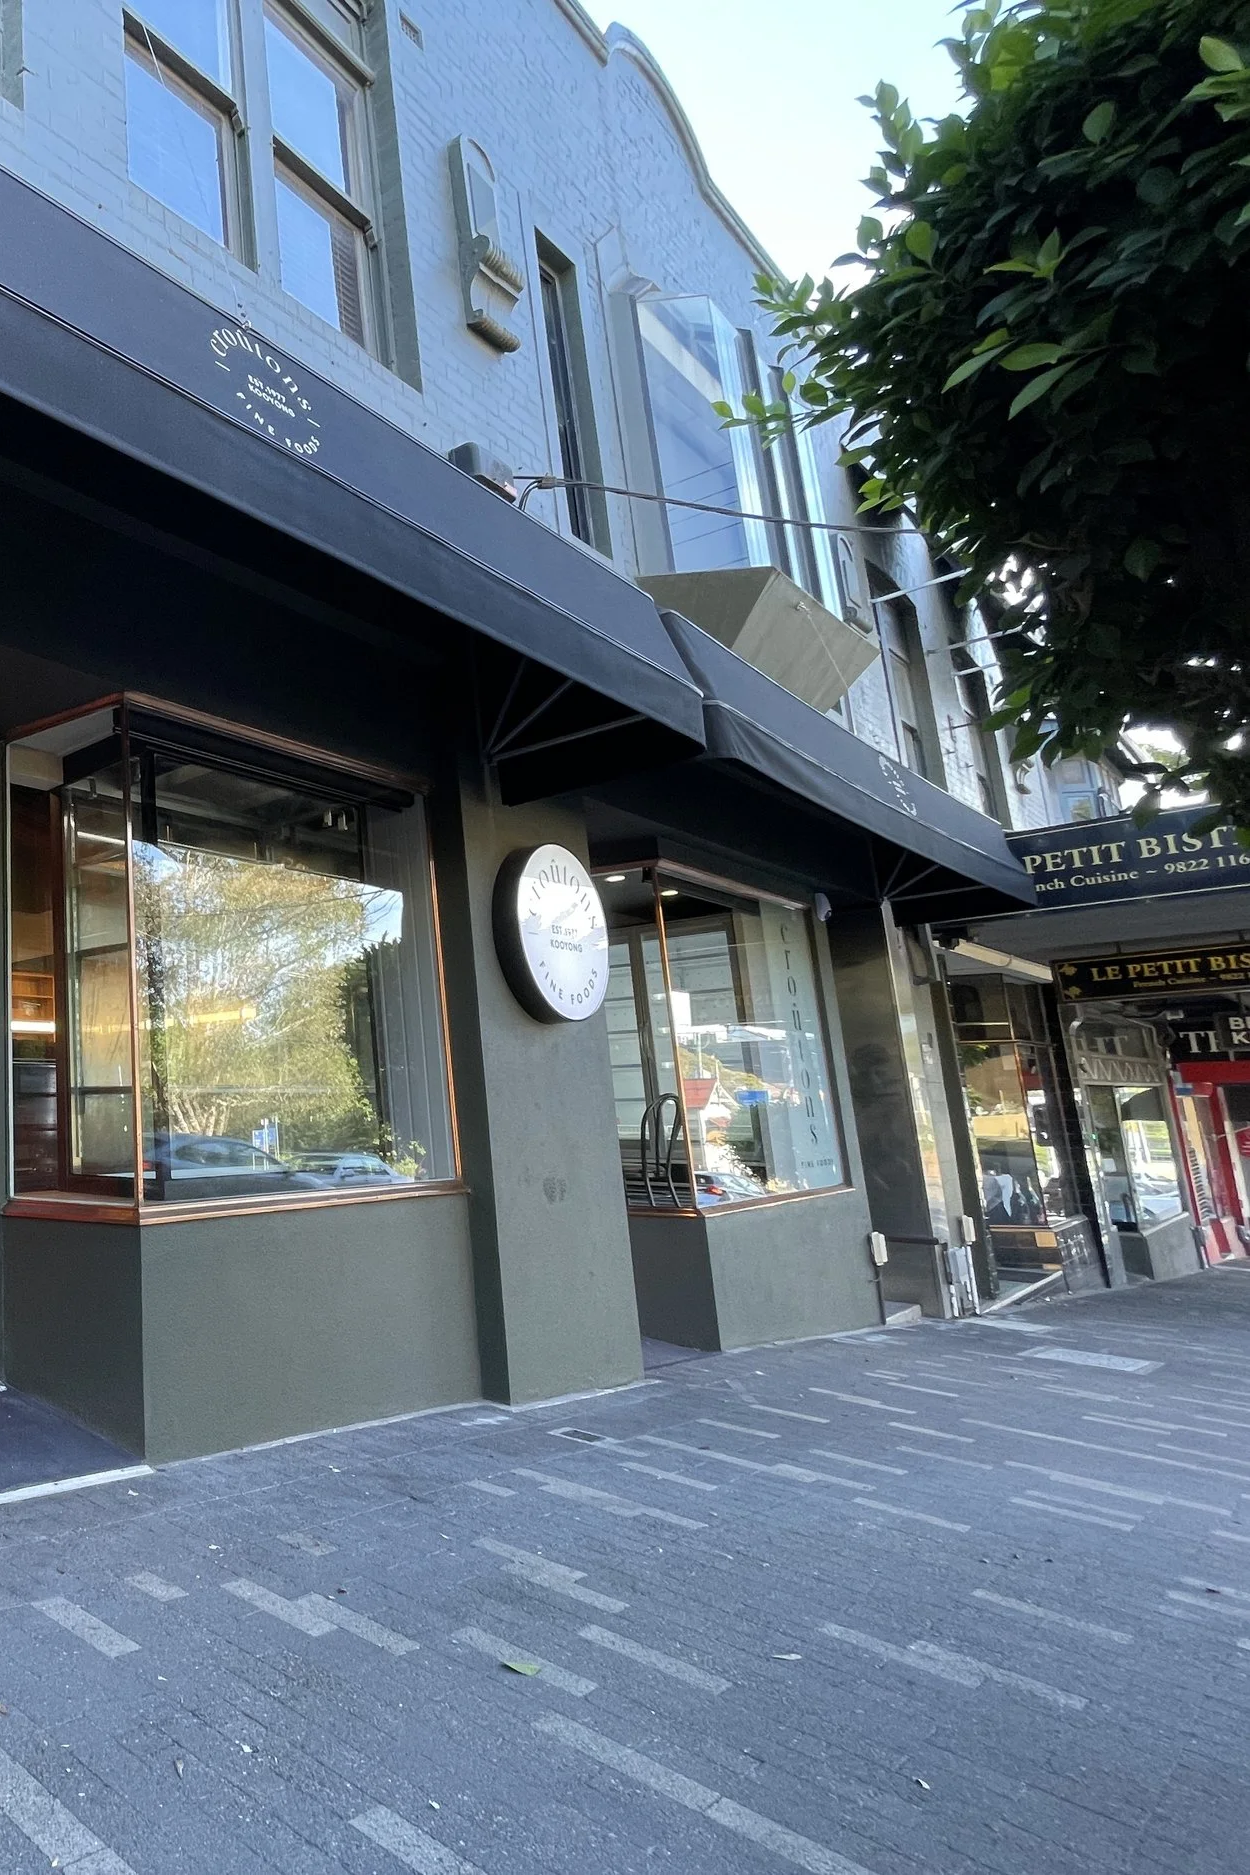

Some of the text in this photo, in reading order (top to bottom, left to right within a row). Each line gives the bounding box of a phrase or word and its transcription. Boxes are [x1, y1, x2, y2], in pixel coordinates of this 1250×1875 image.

[285, 435, 320, 455] FOODS
[1021, 825, 1239, 875] PETIT BIST
[1070, 870, 1140, 887] Cuisine
[1164, 858, 1210, 875] 9822
[550, 939, 583, 953] KOOYONG
[539, 960, 598, 1005] FINE FOODS
[1090, 965, 1123, 981] LE
[1126, 958, 1201, 978] PETIT
